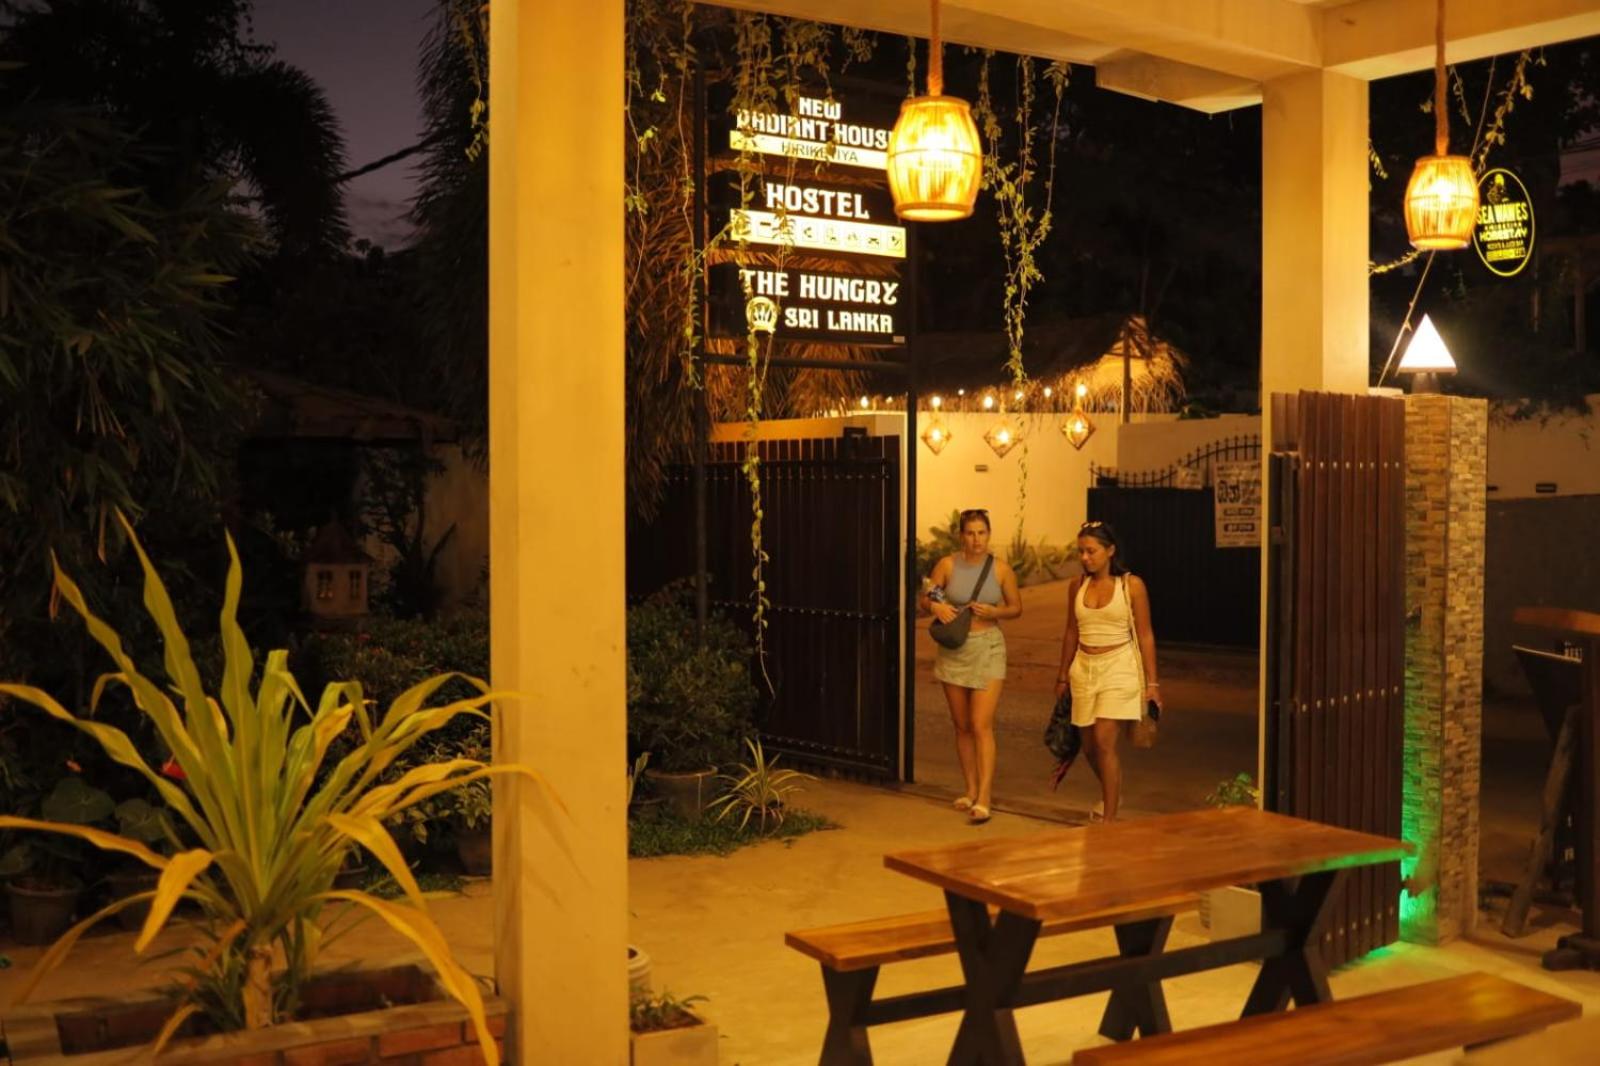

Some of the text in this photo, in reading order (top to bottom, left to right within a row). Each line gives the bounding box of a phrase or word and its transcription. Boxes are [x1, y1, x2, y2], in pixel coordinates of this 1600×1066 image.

[799, 96, 842, 121] NEW
[736, 108, 894, 150] RADIANT HOUS
[766, 182, 870, 220] HOSTEL
[738, 268, 899, 306] THE HUNGRY
[784, 307, 894, 334] SRI LANKA
